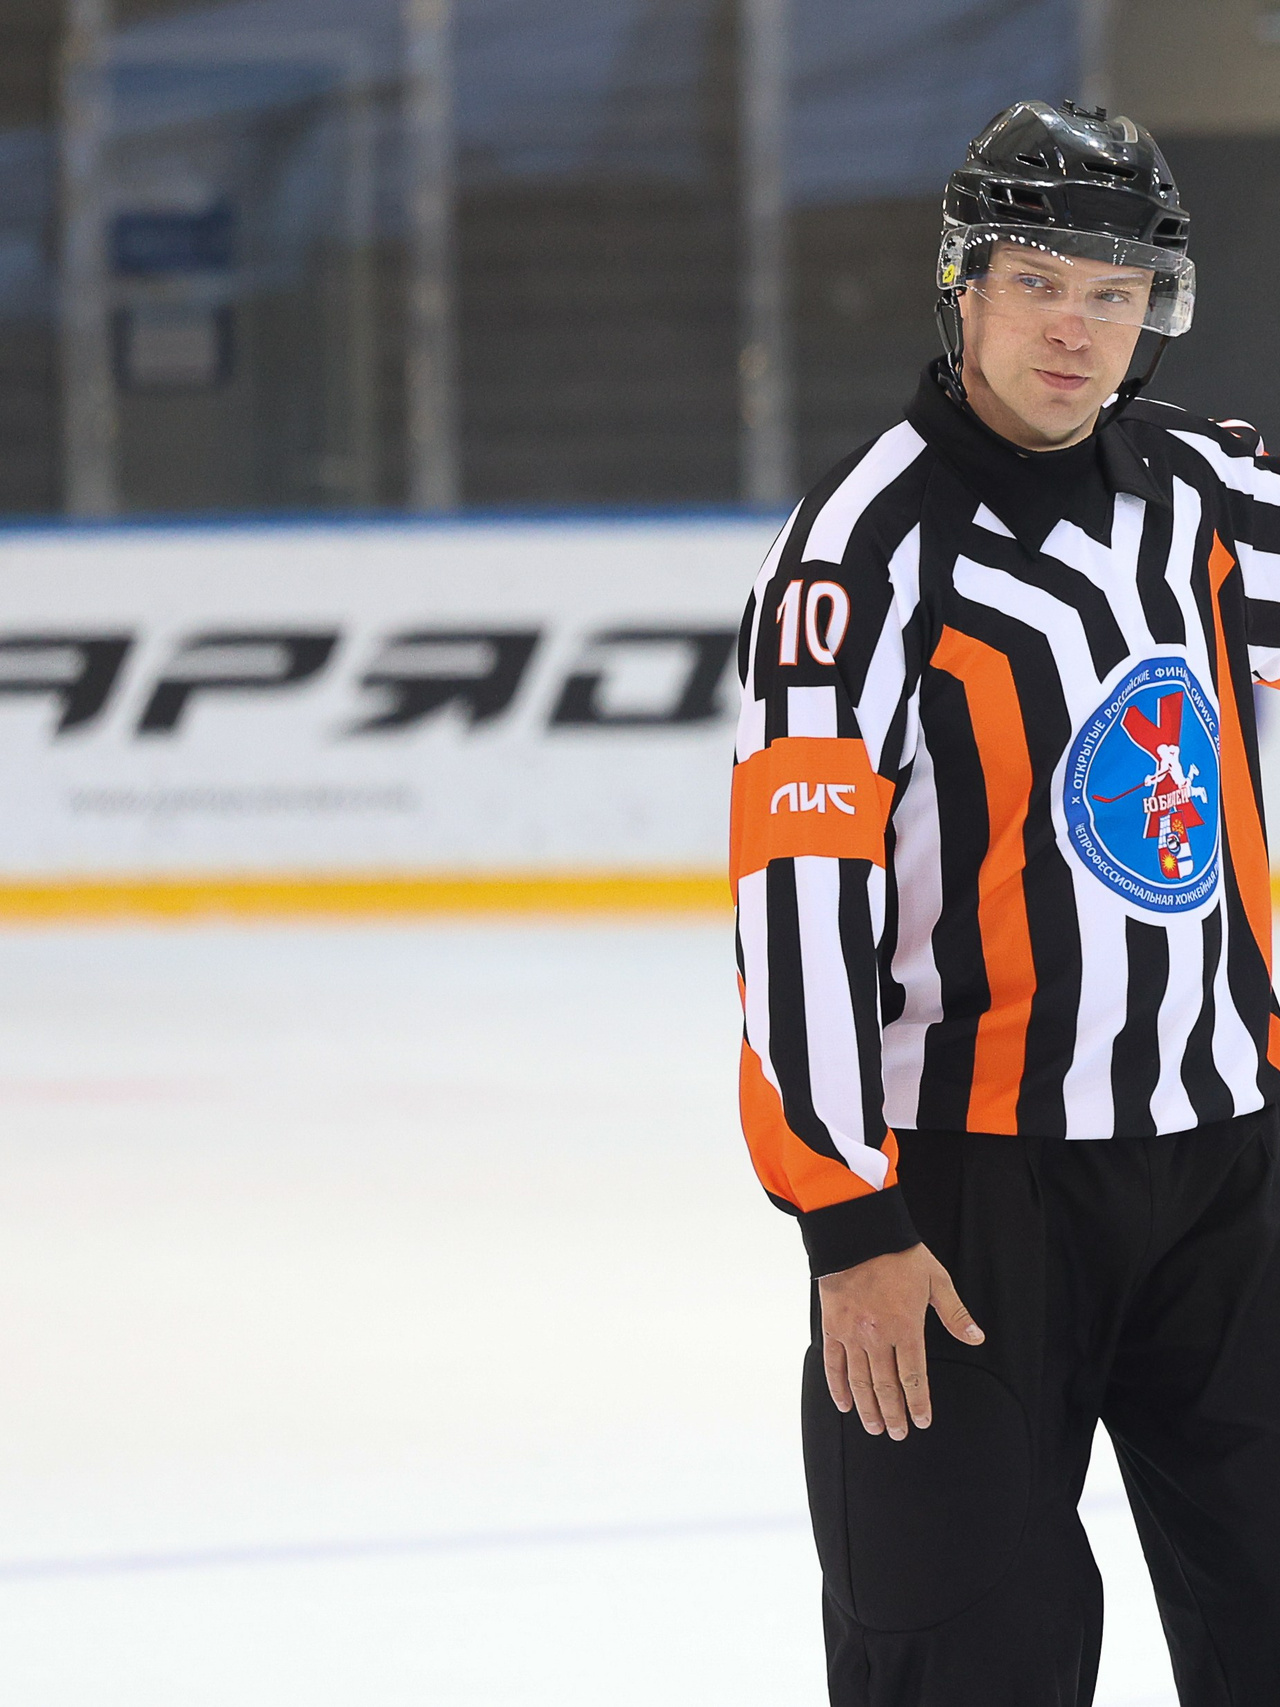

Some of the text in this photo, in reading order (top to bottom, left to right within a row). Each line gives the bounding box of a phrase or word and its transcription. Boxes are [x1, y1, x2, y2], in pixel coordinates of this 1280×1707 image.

[776, 579, 850, 666] 10
[1073, 720, 1106, 790] ОТКРЫТЫЕ
[1190, 687, 1216, 732] СИРИУС
